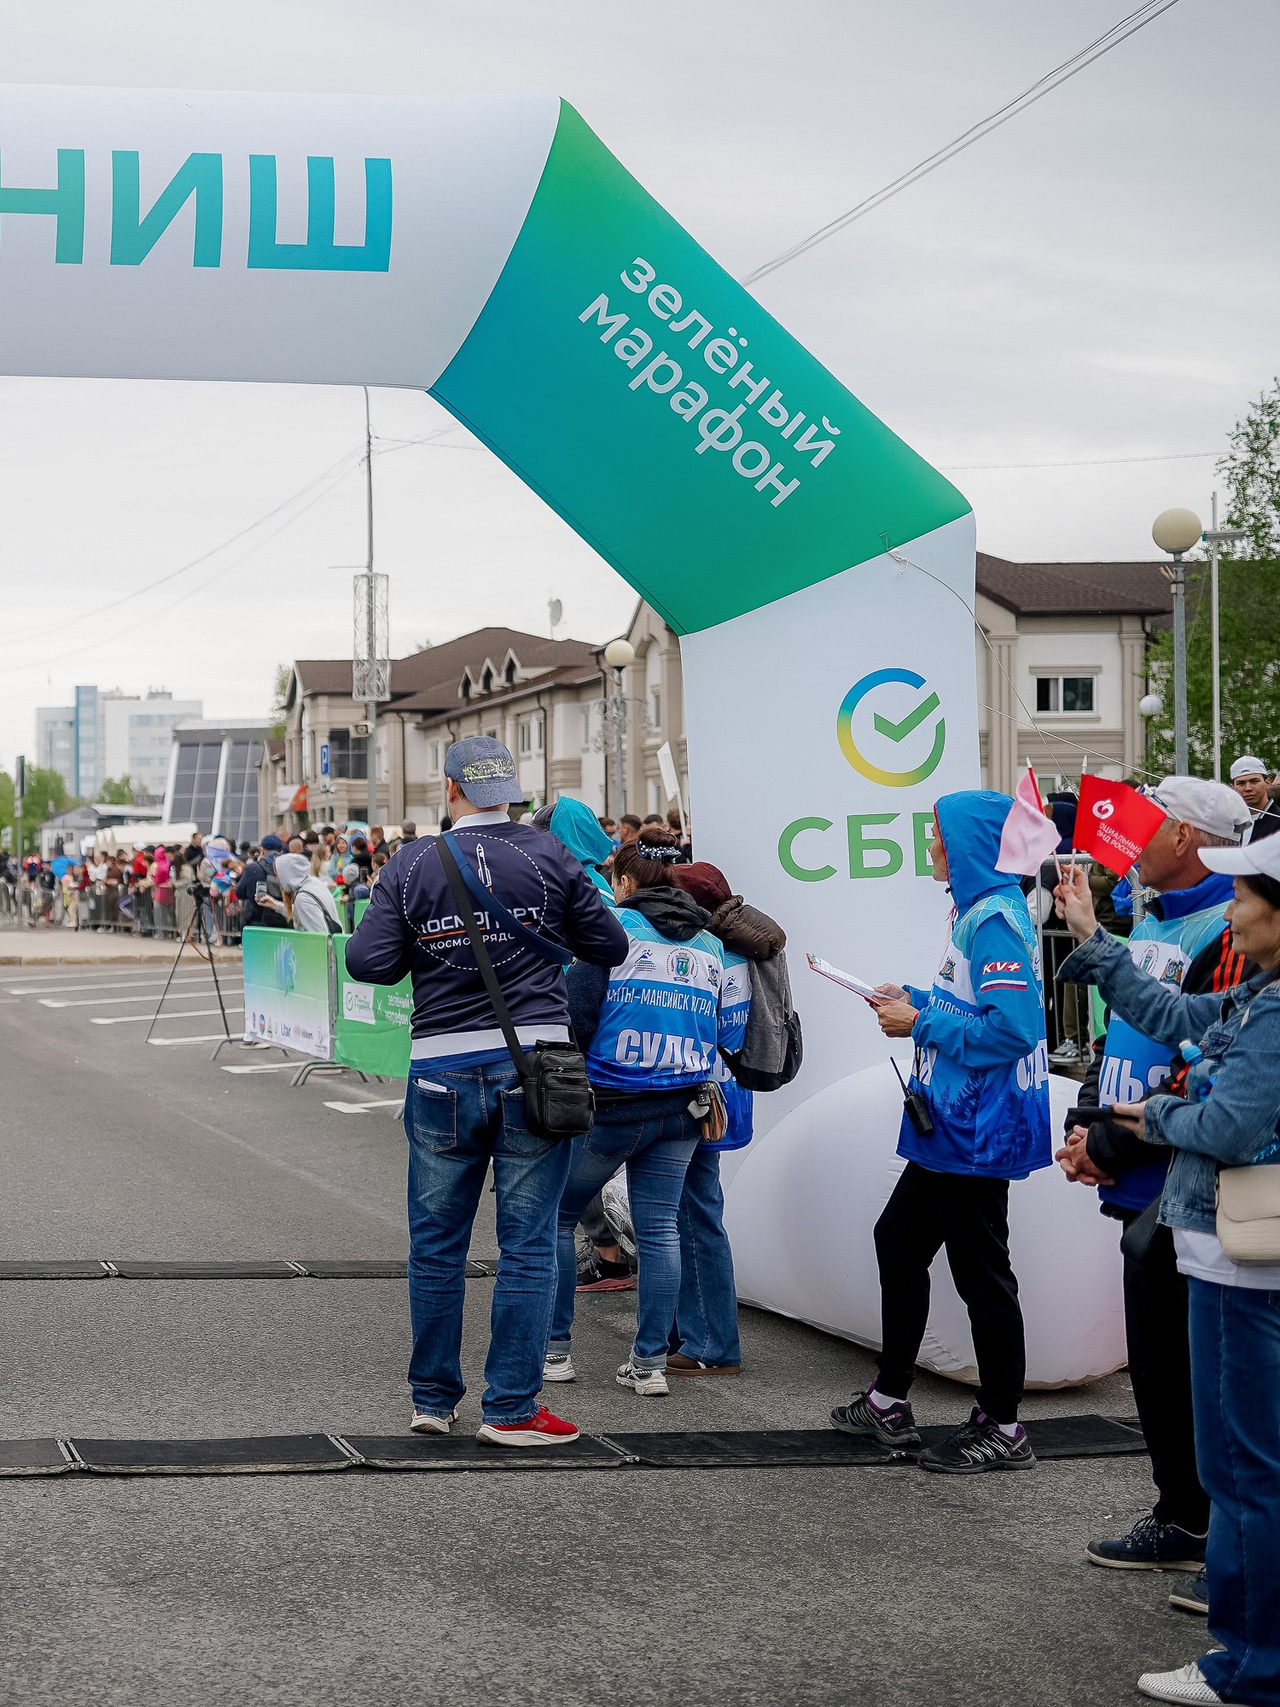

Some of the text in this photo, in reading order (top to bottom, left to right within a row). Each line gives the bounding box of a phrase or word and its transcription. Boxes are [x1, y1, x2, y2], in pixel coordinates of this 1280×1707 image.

[619, 256, 842, 468] зелёный
[577, 292, 801, 508] марафон
[778, 813, 934, 882] СБЕ
[1096, 830, 1110, 844] ОНД
[1099, 821, 1143, 855] ОЦИАЛЬНЫЙ
[430, 937, 471, 950] КОСМО
